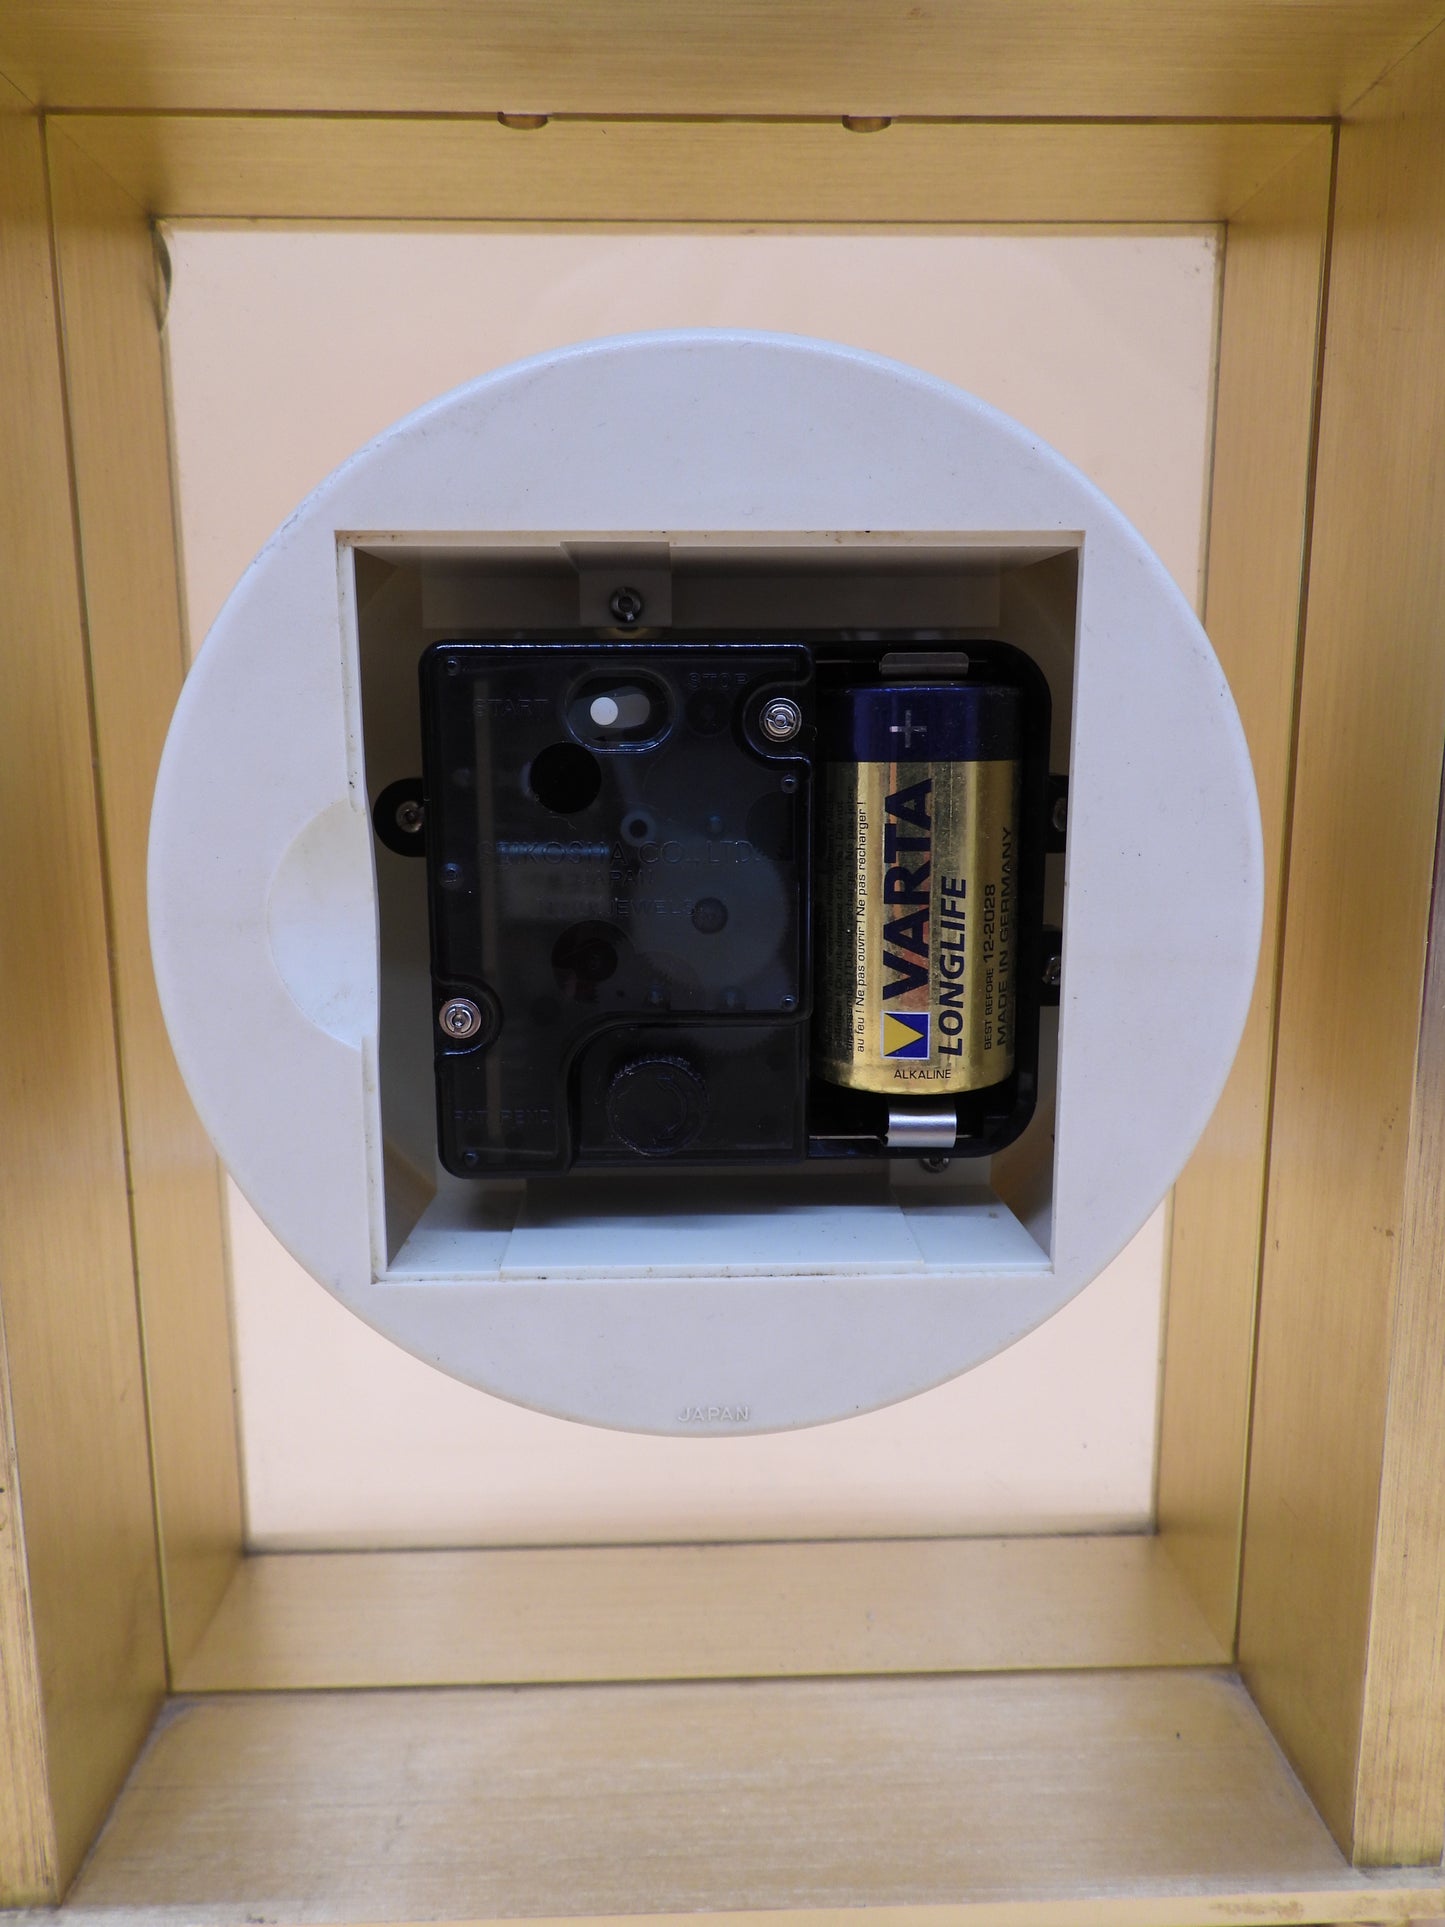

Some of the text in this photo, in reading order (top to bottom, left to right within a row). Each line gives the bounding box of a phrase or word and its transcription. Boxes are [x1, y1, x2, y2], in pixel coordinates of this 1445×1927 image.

[687, 672, 750, 690] STOP
[473, 698, 549, 718] START
[856, 809, 868, 870] recharger
[479, 840, 628, 864] SEIKOSHA
[579, 869, 656, 886] JAPAN
[858, 874, 868, 895] pas
[883, 778, 932, 1001] VARTA
[856, 899, 865, 916] Ne
[857, 927, 866, 962] ouvrir
[997, 826, 1012, 1046] MADE IN GERMANY
[857, 965, 868, 986] pas
[938, 876, 966, 1057] LONGLIFE
[983, 884, 996, 1050] BEST BEFORE 12-2028
[856, 990, 864, 1007] Ne
[855, 1018, 864, 1035] feu
[857, 1039, 864, 1052] au
[893, 1069, 952, 1081] ALKALINE
[678, 1407, 750, 1422] JAPAN
